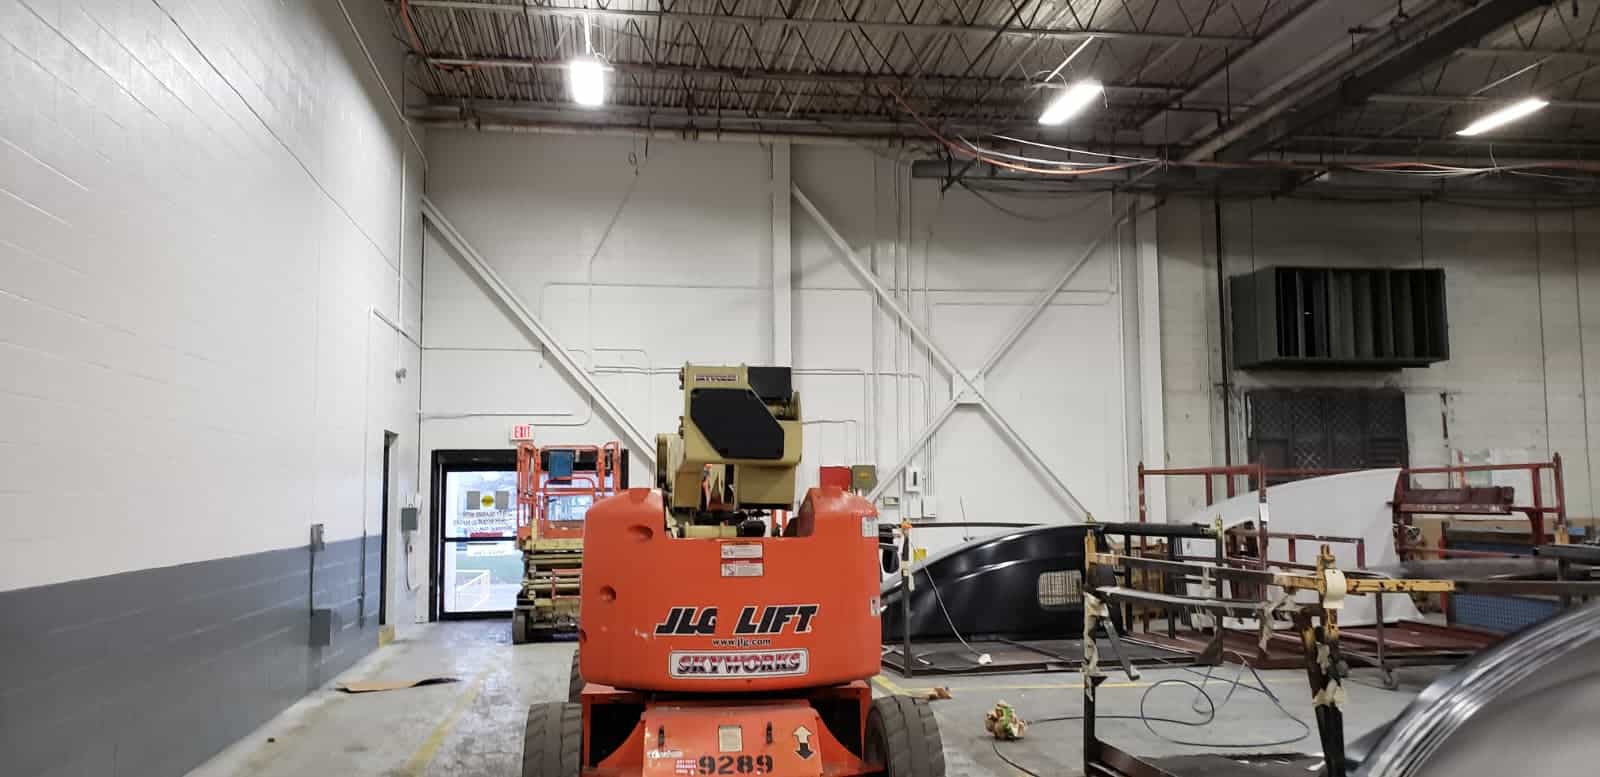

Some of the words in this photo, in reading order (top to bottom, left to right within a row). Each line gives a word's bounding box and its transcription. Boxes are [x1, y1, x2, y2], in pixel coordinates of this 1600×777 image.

[655, 606, 718, 634] JLG
[734, 604, 819, 634] LIFT
[712, 637, 771, 647] www.jlg.com
[677, 653, 801, 675] SKYWORKS
[699, 755, 773, 774] 9289
